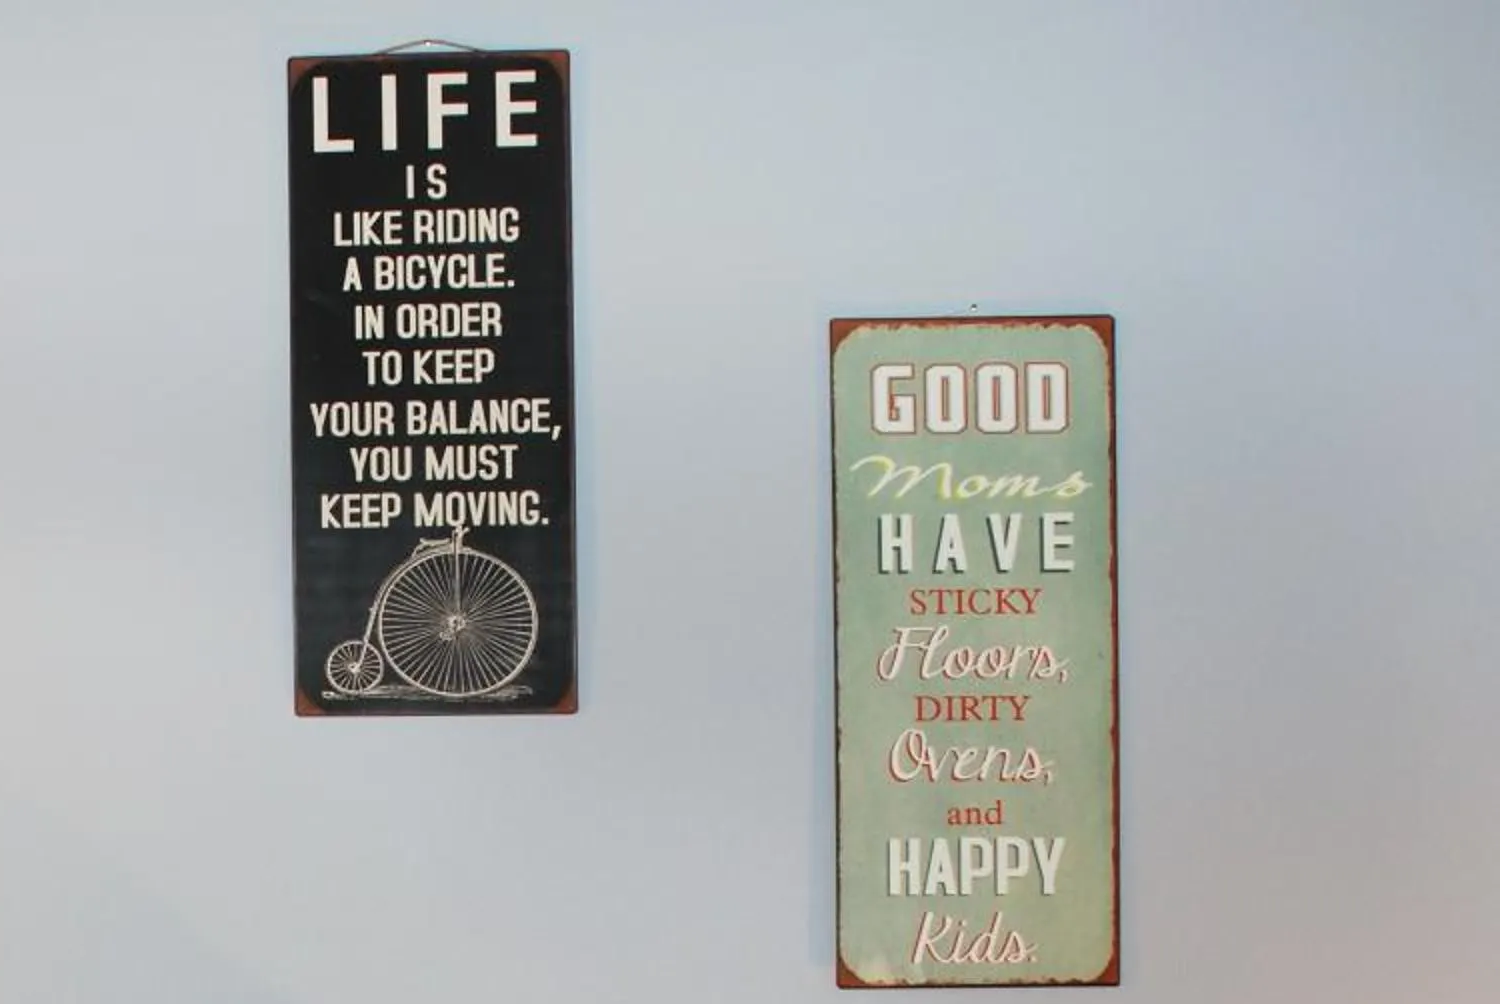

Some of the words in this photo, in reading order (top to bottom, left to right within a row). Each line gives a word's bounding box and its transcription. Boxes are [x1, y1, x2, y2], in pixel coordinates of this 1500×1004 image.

[312, 69, 537, 153] LIFE
[405, 163, 447, 199] IS
[333, 211, 403, 247] LIKE
[413, 206, 520, 245] RIDING
[342, 256, 363, 292] A
[374, 253, 515, 291] BICYCLE.
[355, 305, 384, 340] IN
[396, 302, 503, 339] ORDER
[362, 350, 402, 386] TO
[413, 348, 496, 384] KEEP
[870, 361, 1069, 435] GOOD
[310, 401, 395, 437] YOUR
[407, 398, 562, 441] BALANCE,
[349, 446, 413, 482] YOU
[425, 444, 519, 481] MUST
[849, 455, 1093, 500] Moms
[321, 494, 401, 529] KEEP
[414, 490, 549, 528] MOVING.
[878, 511, 1075, 574] HAVE
[909, 587, 1043, 615] STICKY
[877, 626, 1070, 683] Floors,
[915, 695, 1031, 722] DIRTY
[888, 729, 1054, 786] Ovens,
[947, 799, 1004, 826] and
[887, 836, 1066, 897] HAPPY
[911, 911, 1038, 966] Kids.
